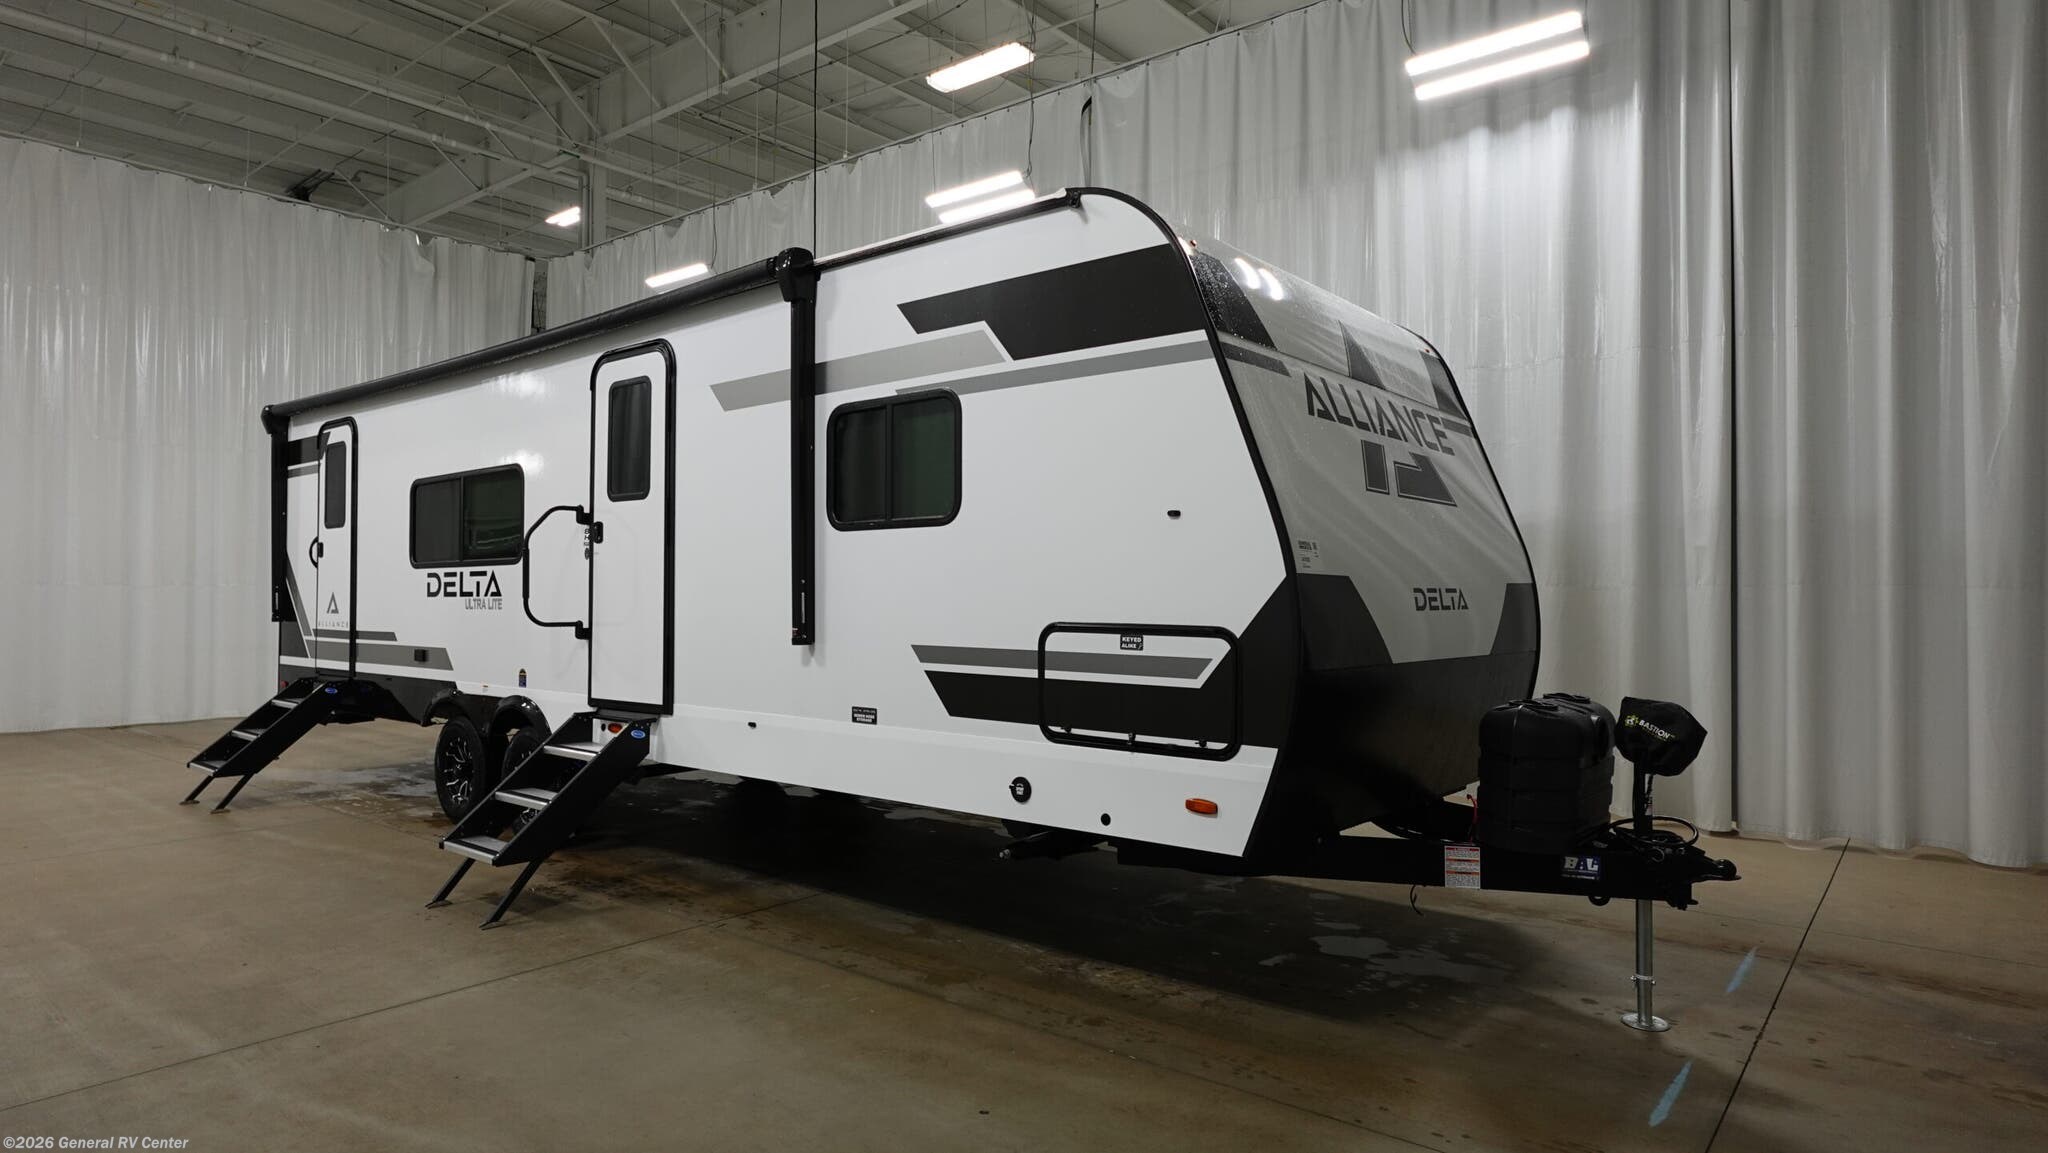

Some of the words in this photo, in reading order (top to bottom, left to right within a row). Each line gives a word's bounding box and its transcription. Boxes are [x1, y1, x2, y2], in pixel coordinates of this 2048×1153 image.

[1303, 372, 1456, 456] ALLIANCE
[427, 569, 503, 598] DELTA
[464, 598, 487, 610] ULTRA
[488, 597, 503, 610] LITE
[1412, 587, 1470, 612] DELTA
[1638, 719, 1671, 739] BASTION
